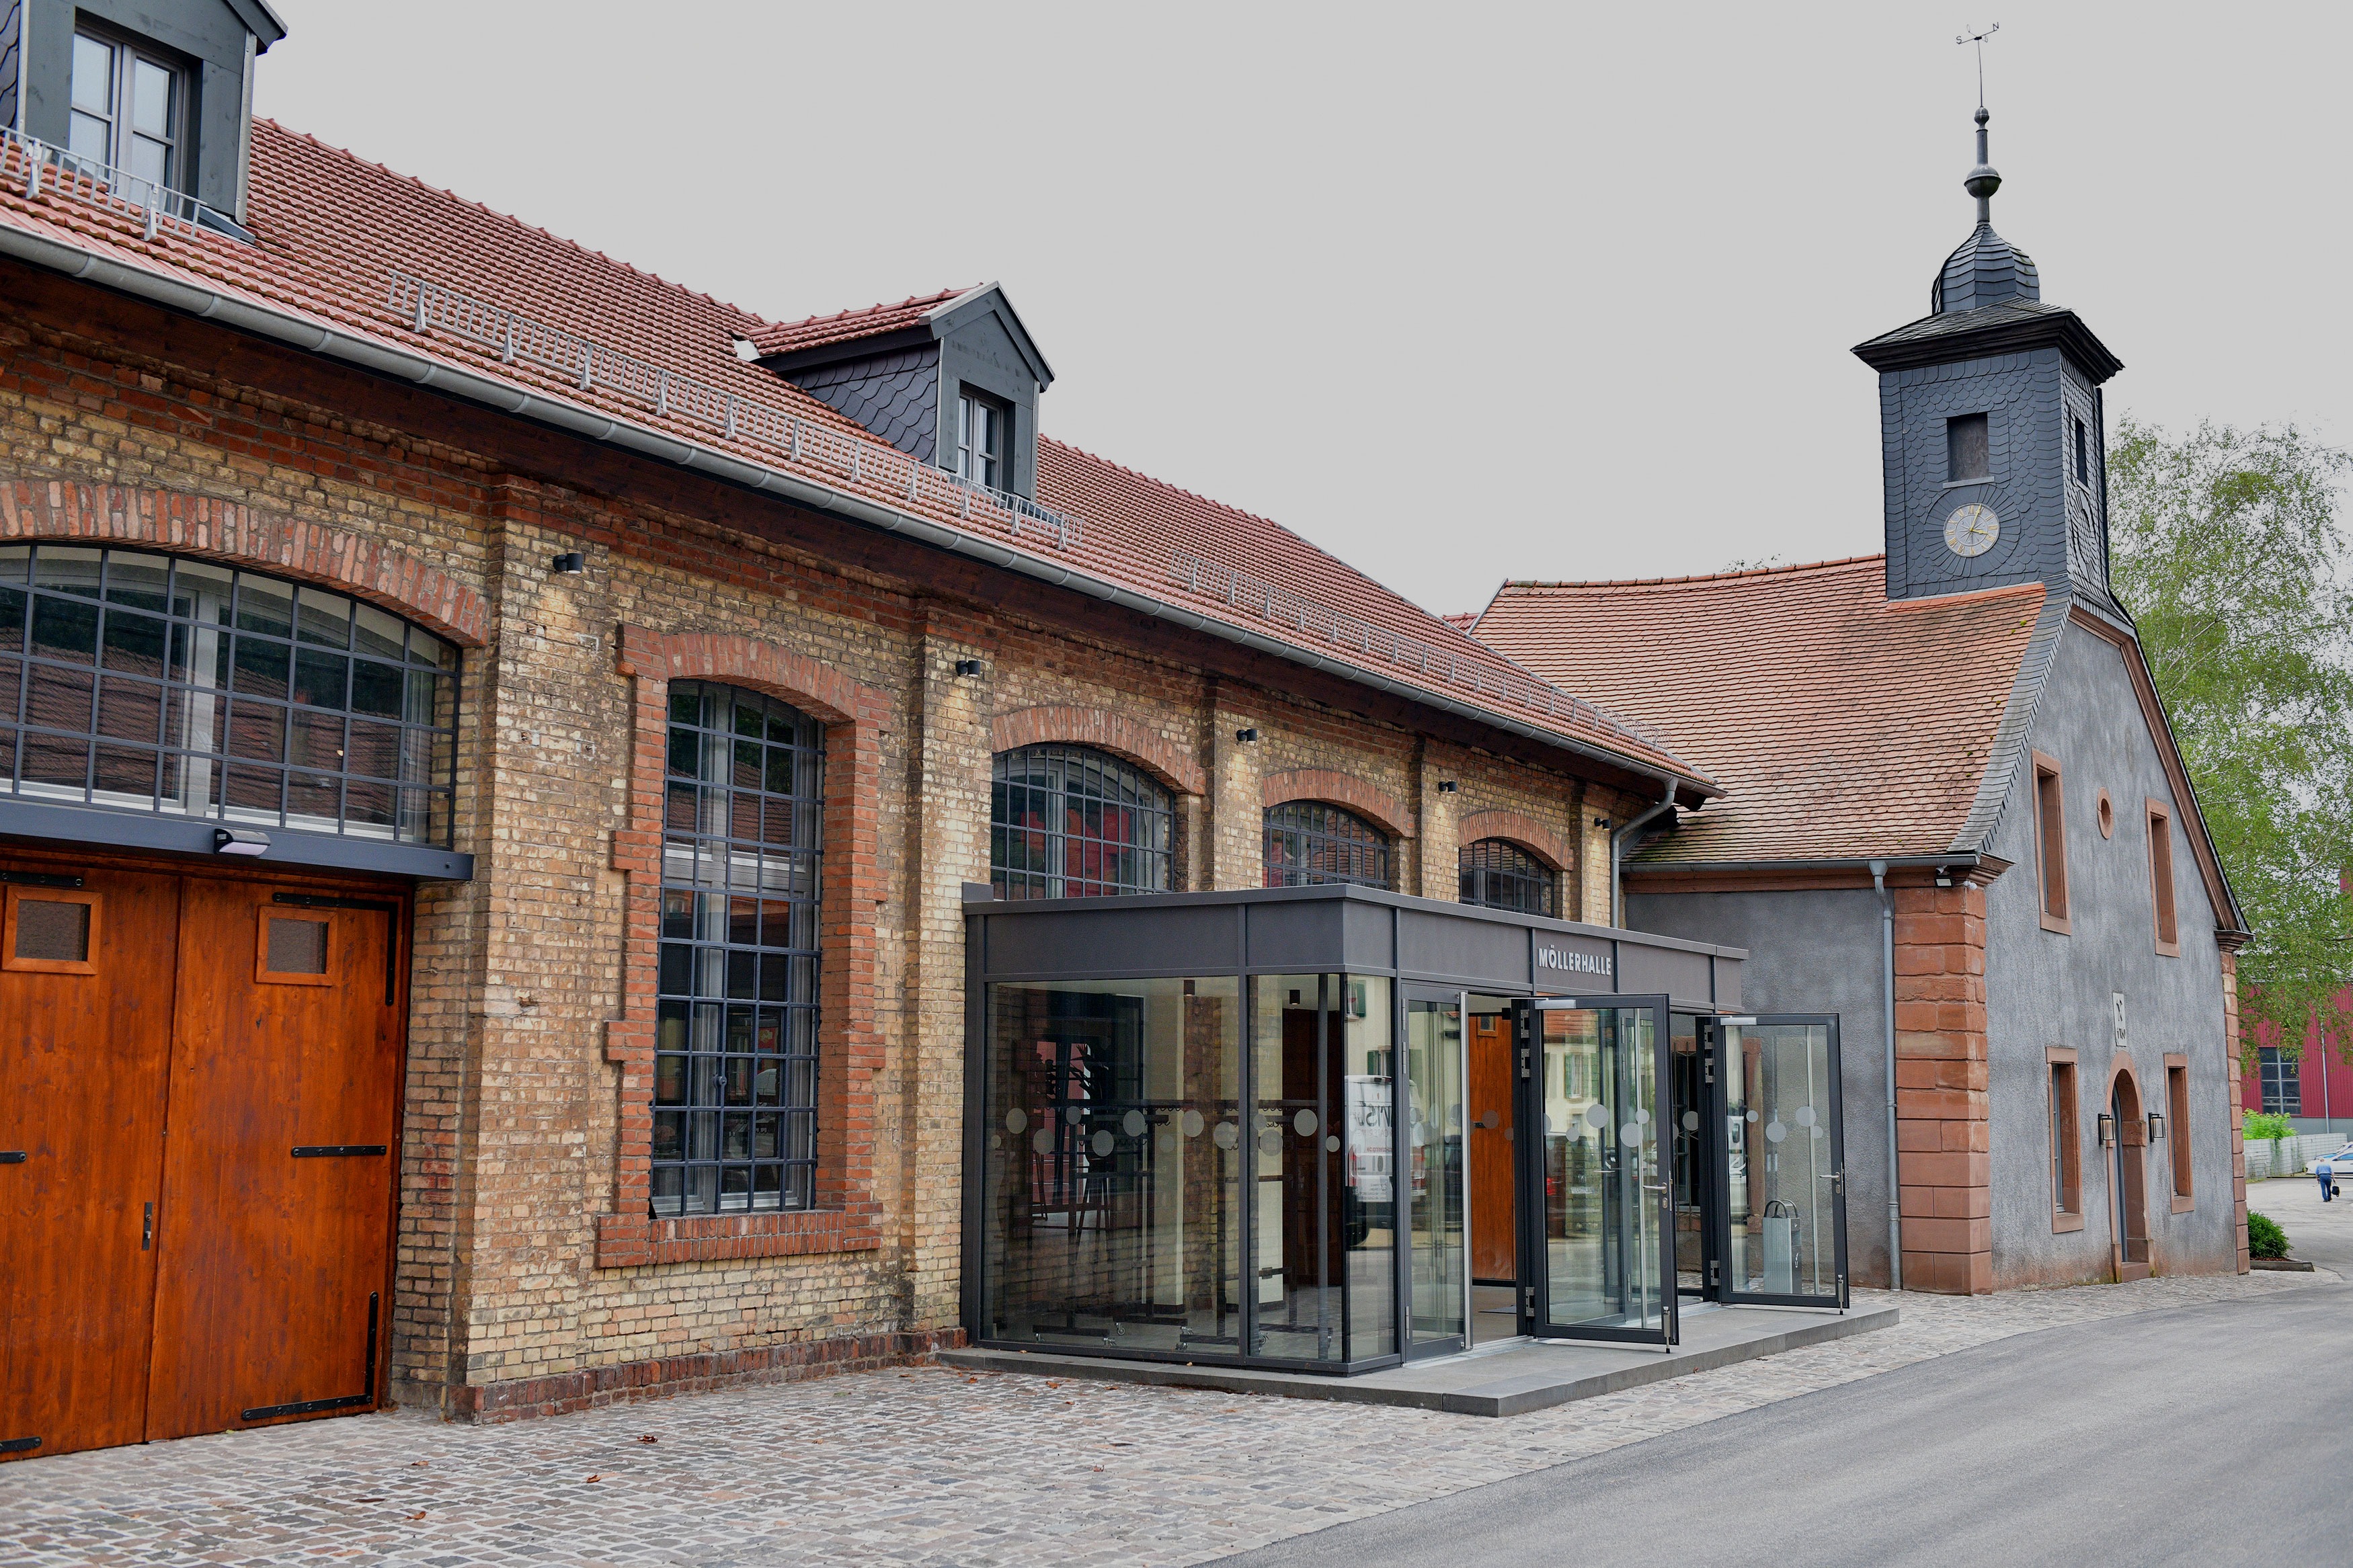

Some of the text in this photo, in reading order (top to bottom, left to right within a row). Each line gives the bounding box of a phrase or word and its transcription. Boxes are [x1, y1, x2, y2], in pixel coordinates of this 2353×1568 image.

[1993, 22, 1999, 32] N
[1956, 36, 1962, 44] S
[1538, 944, 1611, 975] MÖLLERHALLE
